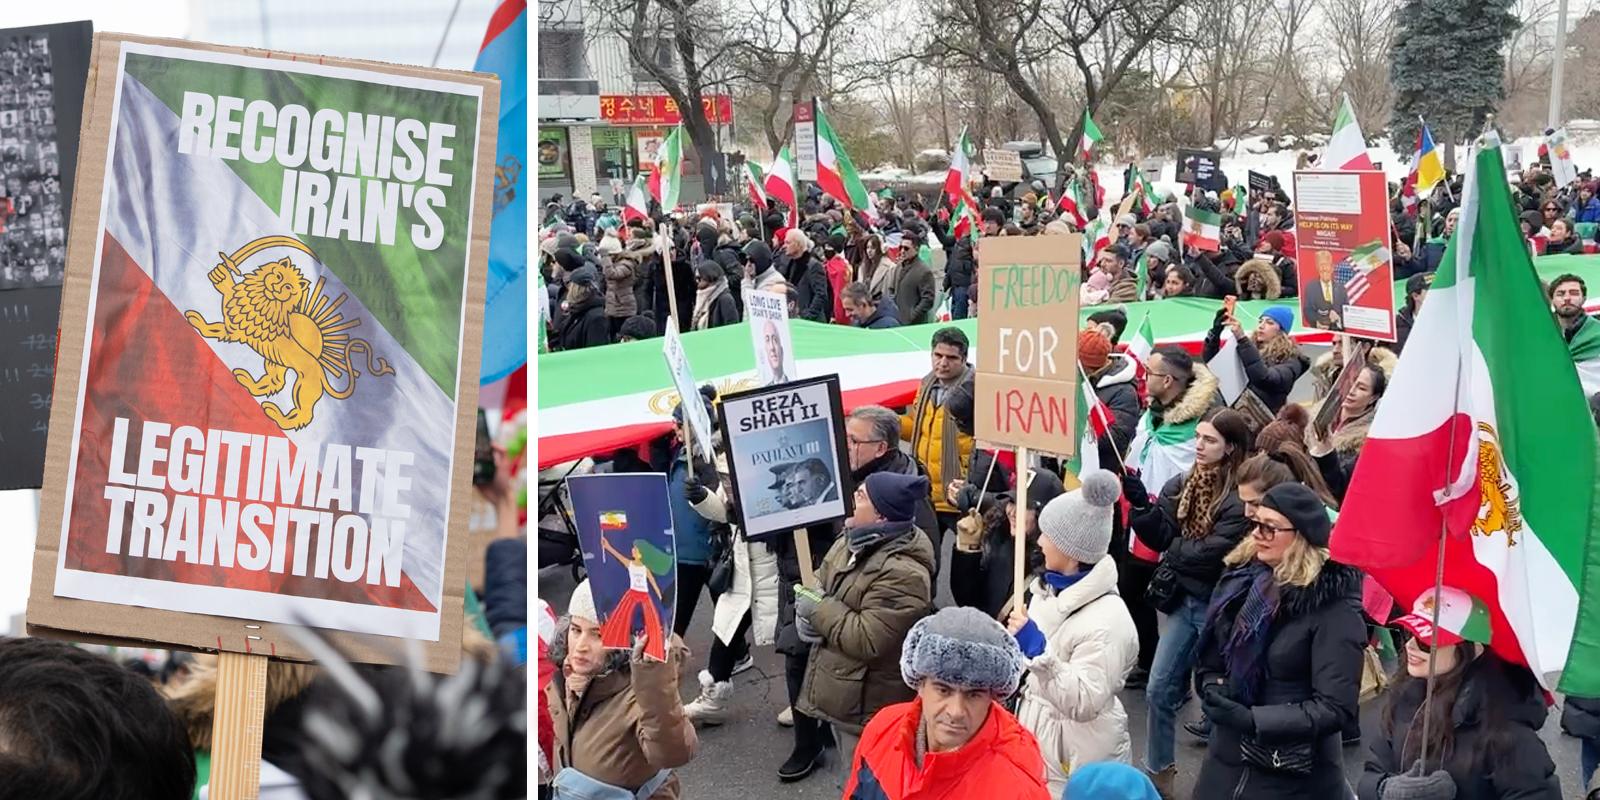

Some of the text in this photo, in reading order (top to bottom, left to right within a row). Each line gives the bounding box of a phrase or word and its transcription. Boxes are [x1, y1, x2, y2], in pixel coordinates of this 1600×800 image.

[178, 91, 456, 186] RECOGNISE
[279, 169, 447, 250] IRAN'S
[750, 295, 781, 311] LONG LIVE
[991, 263, 1080, 310] FREEDOM
[998, 326, 1058, 377] FOR
[740, 403, 820, 432] SHAH II
[752, 392, 804, 414] REZA
[995, 389, 1068, 436] IRAN
[107, 417, 415, 518] LEGITIMATE
[103, 485, 406, 588] TRANSITION
